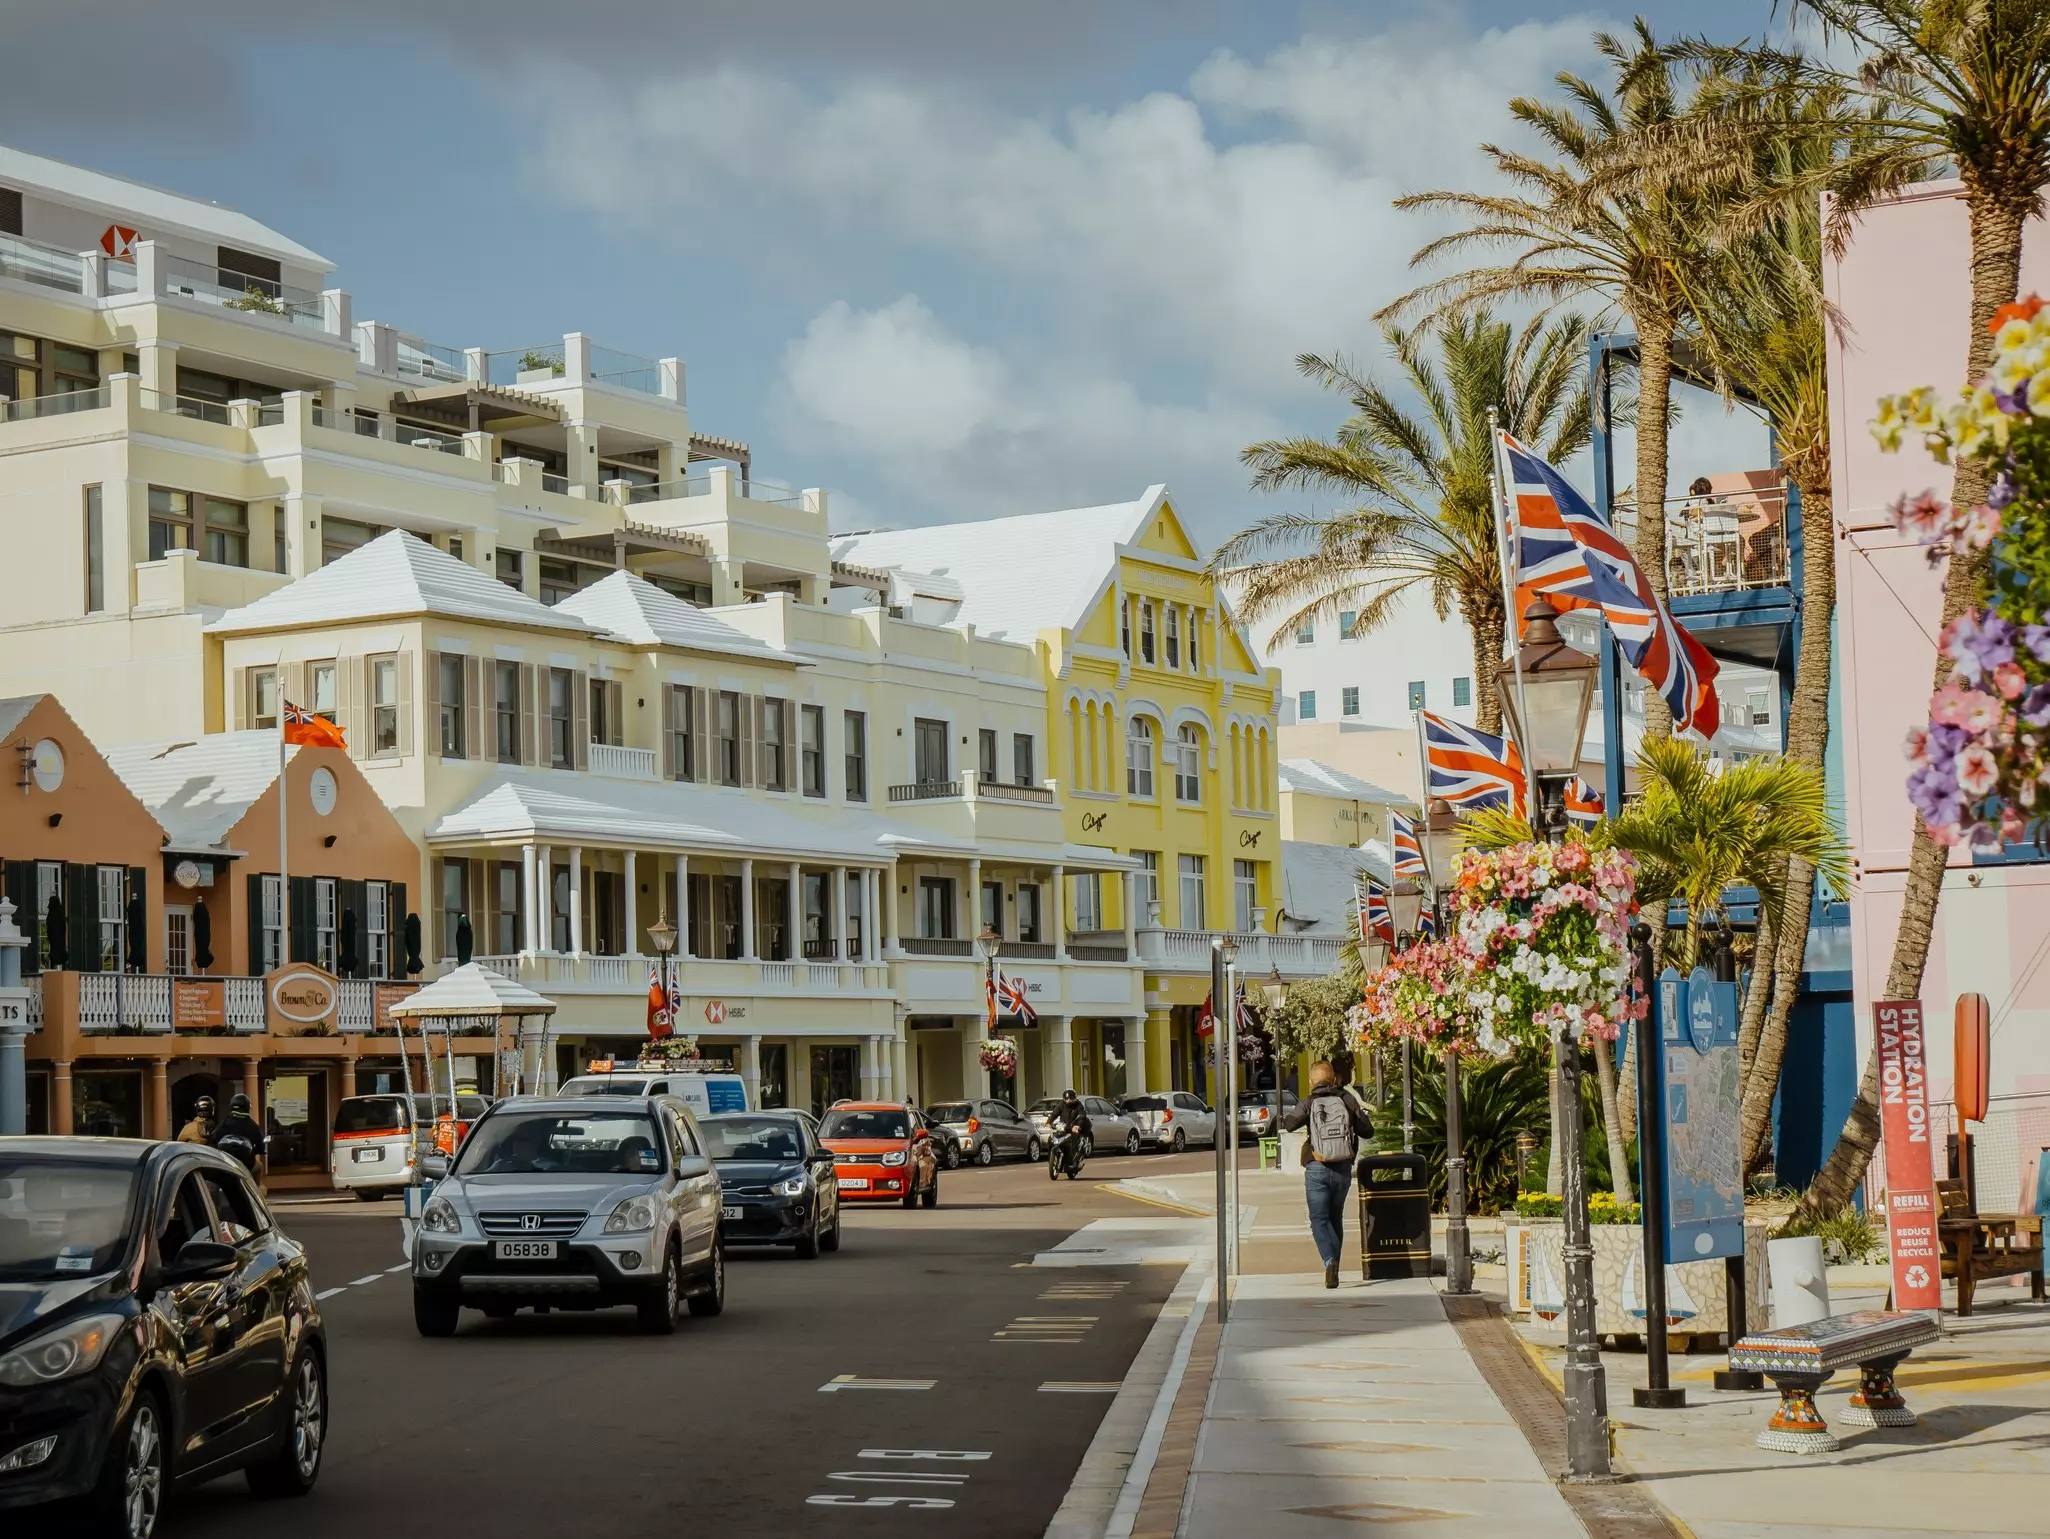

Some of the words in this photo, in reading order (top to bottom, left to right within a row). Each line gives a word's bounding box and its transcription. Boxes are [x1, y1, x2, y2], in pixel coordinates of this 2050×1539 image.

[1028, 983, 1042, 992] HSBC
[281, 991, 305, 1004] Brown
[314, 992, 328, 1005] Co.
[728, 1007, 746, 1017] HSBC
[1879, 1008, 1903, 1104] STATION
[1901, 1008, 1927, 1143] HYDRATION
[1893, 1195, 1929, 1206] REFILL
[1896, 1227, 1931, 1236] REDUCE
[1901, 1237, 1928, 1246] REUSE
[503, 1244, 549, 1256] 05838
[1897, 1247, 1933, 1257] RECYCLE
[805, 1448, 993, 1508] BUS
